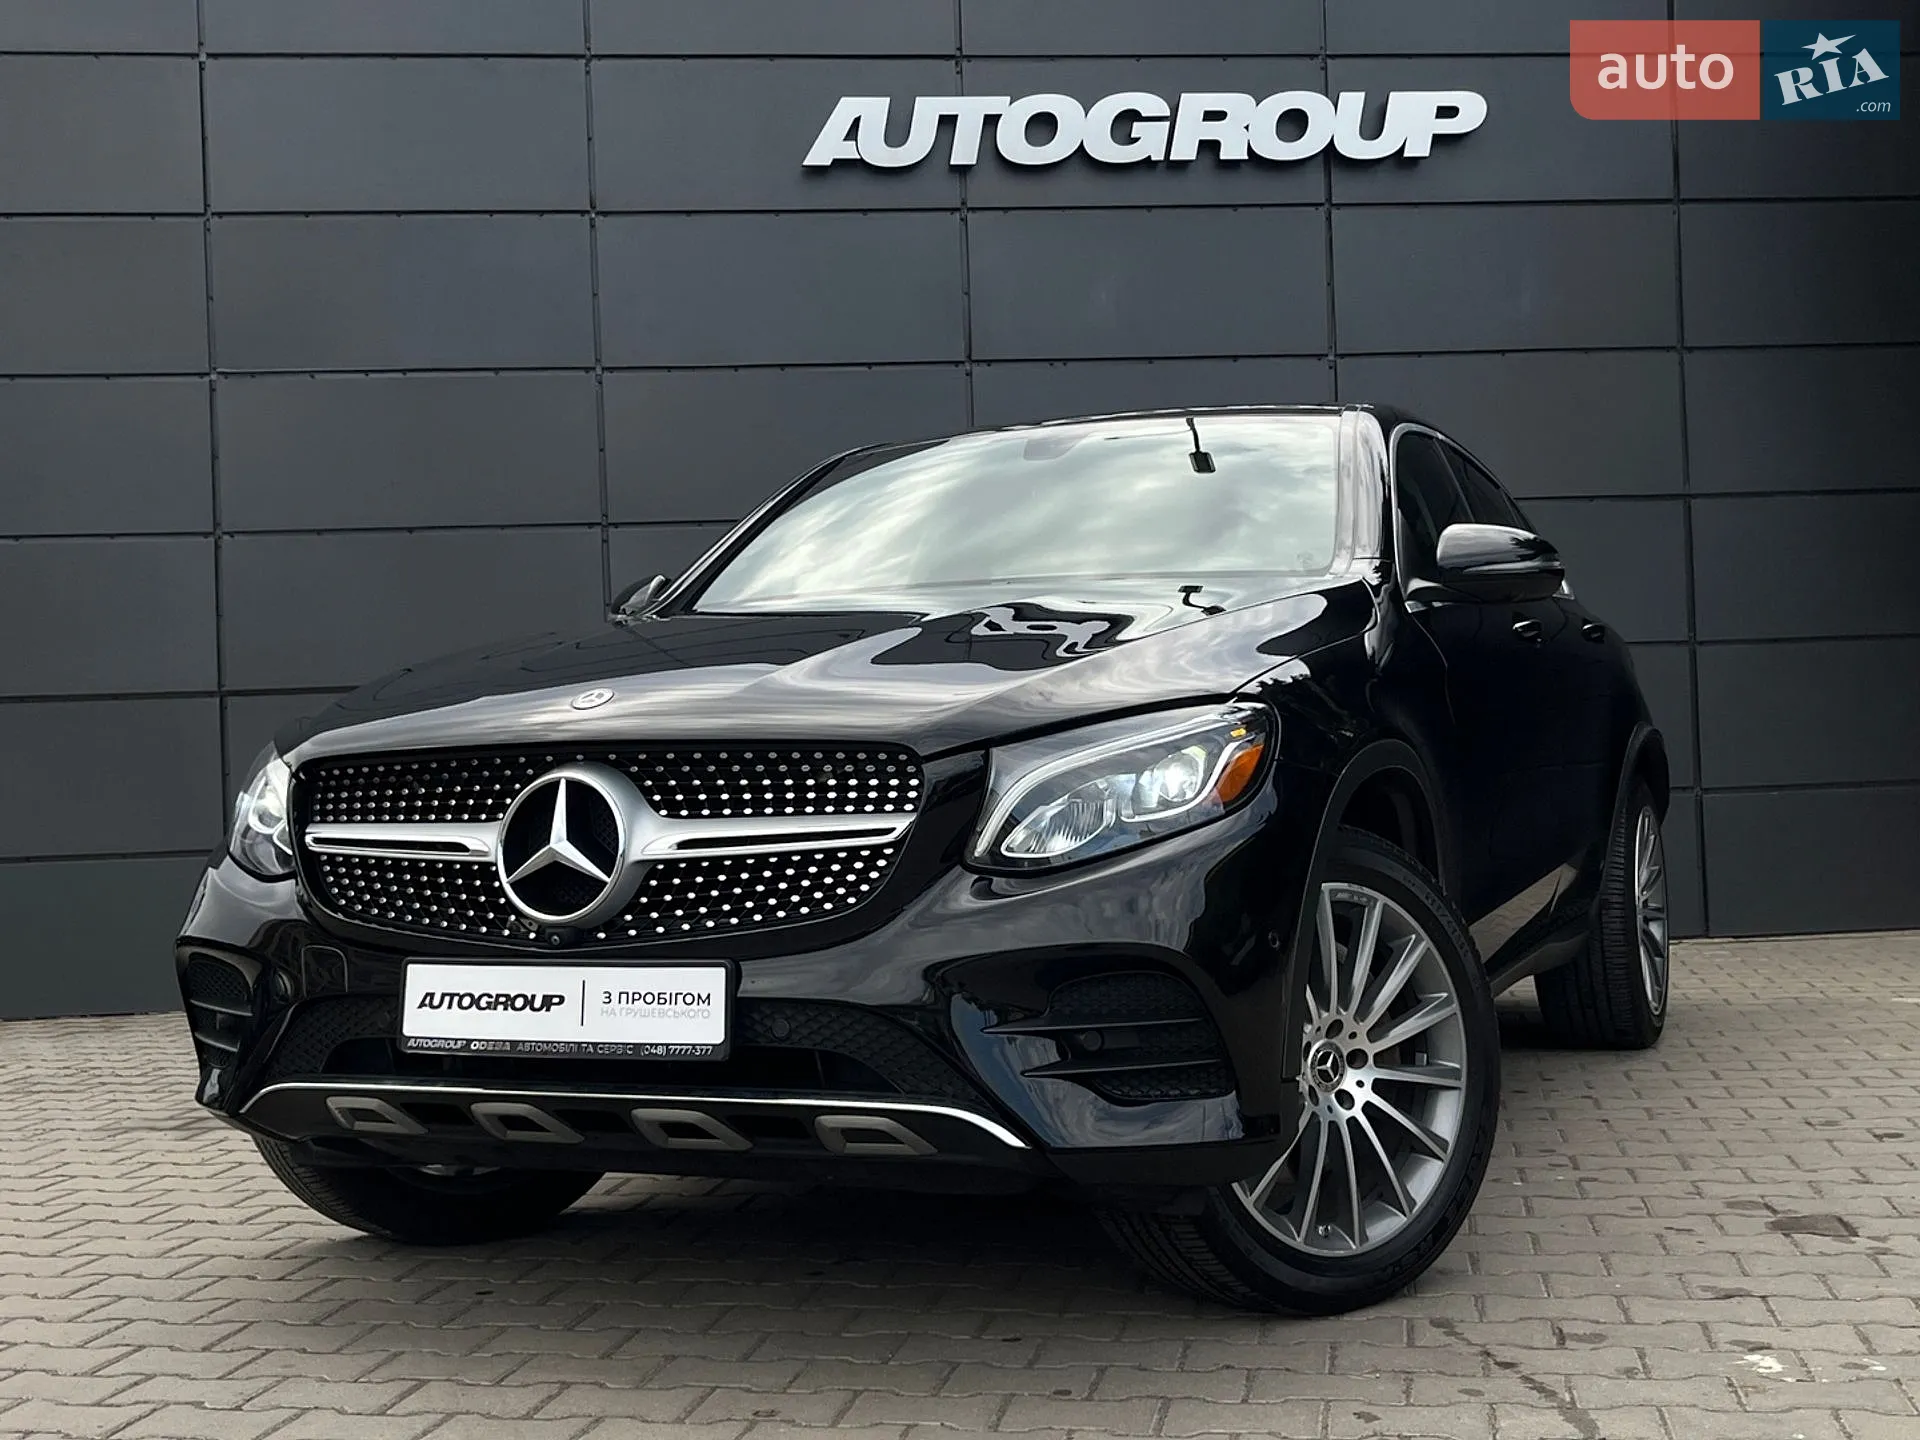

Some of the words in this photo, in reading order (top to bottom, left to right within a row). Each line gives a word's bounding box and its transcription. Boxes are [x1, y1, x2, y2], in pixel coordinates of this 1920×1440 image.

[802, 90, 1488, 168] AUTOGROUP
[416, 992, 565, 1012] AUTOGROUP
[618, 992, 711, 1006] ПРОБІГОМ
[600, 1008, 617, 1017] НА
[619, 1008, 711, 1020] ГРУШЕВСЬКОГО
[407, 1038, 466, 1050] AUTOGROUP
[581, 1043, 594, 1053] ТА
[640, 1045, 667, 1056] (048)
